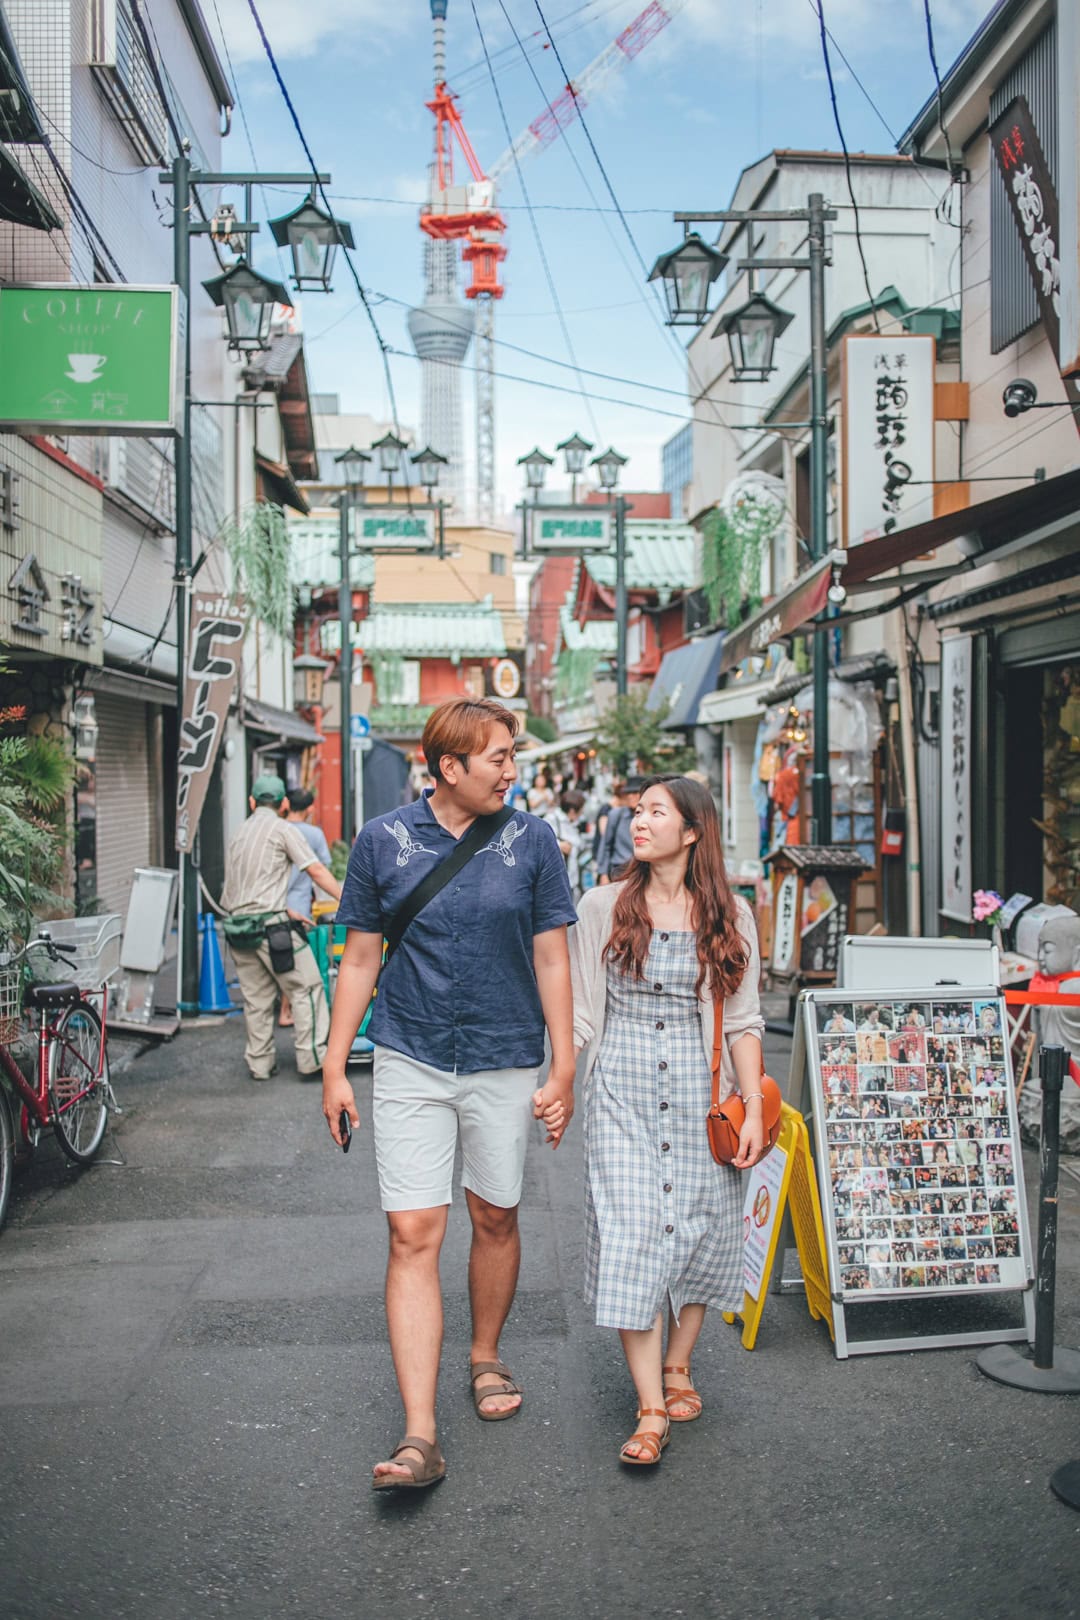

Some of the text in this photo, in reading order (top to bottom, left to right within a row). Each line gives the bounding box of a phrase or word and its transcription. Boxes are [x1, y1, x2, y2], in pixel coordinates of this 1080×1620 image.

[1012, 162, 1060, 319] 蒟蒻
[23, 297, 148, 327] COFFEE
[58, 323, 112, 336] SHOP
[873, 352, 909, 371] 浅草
